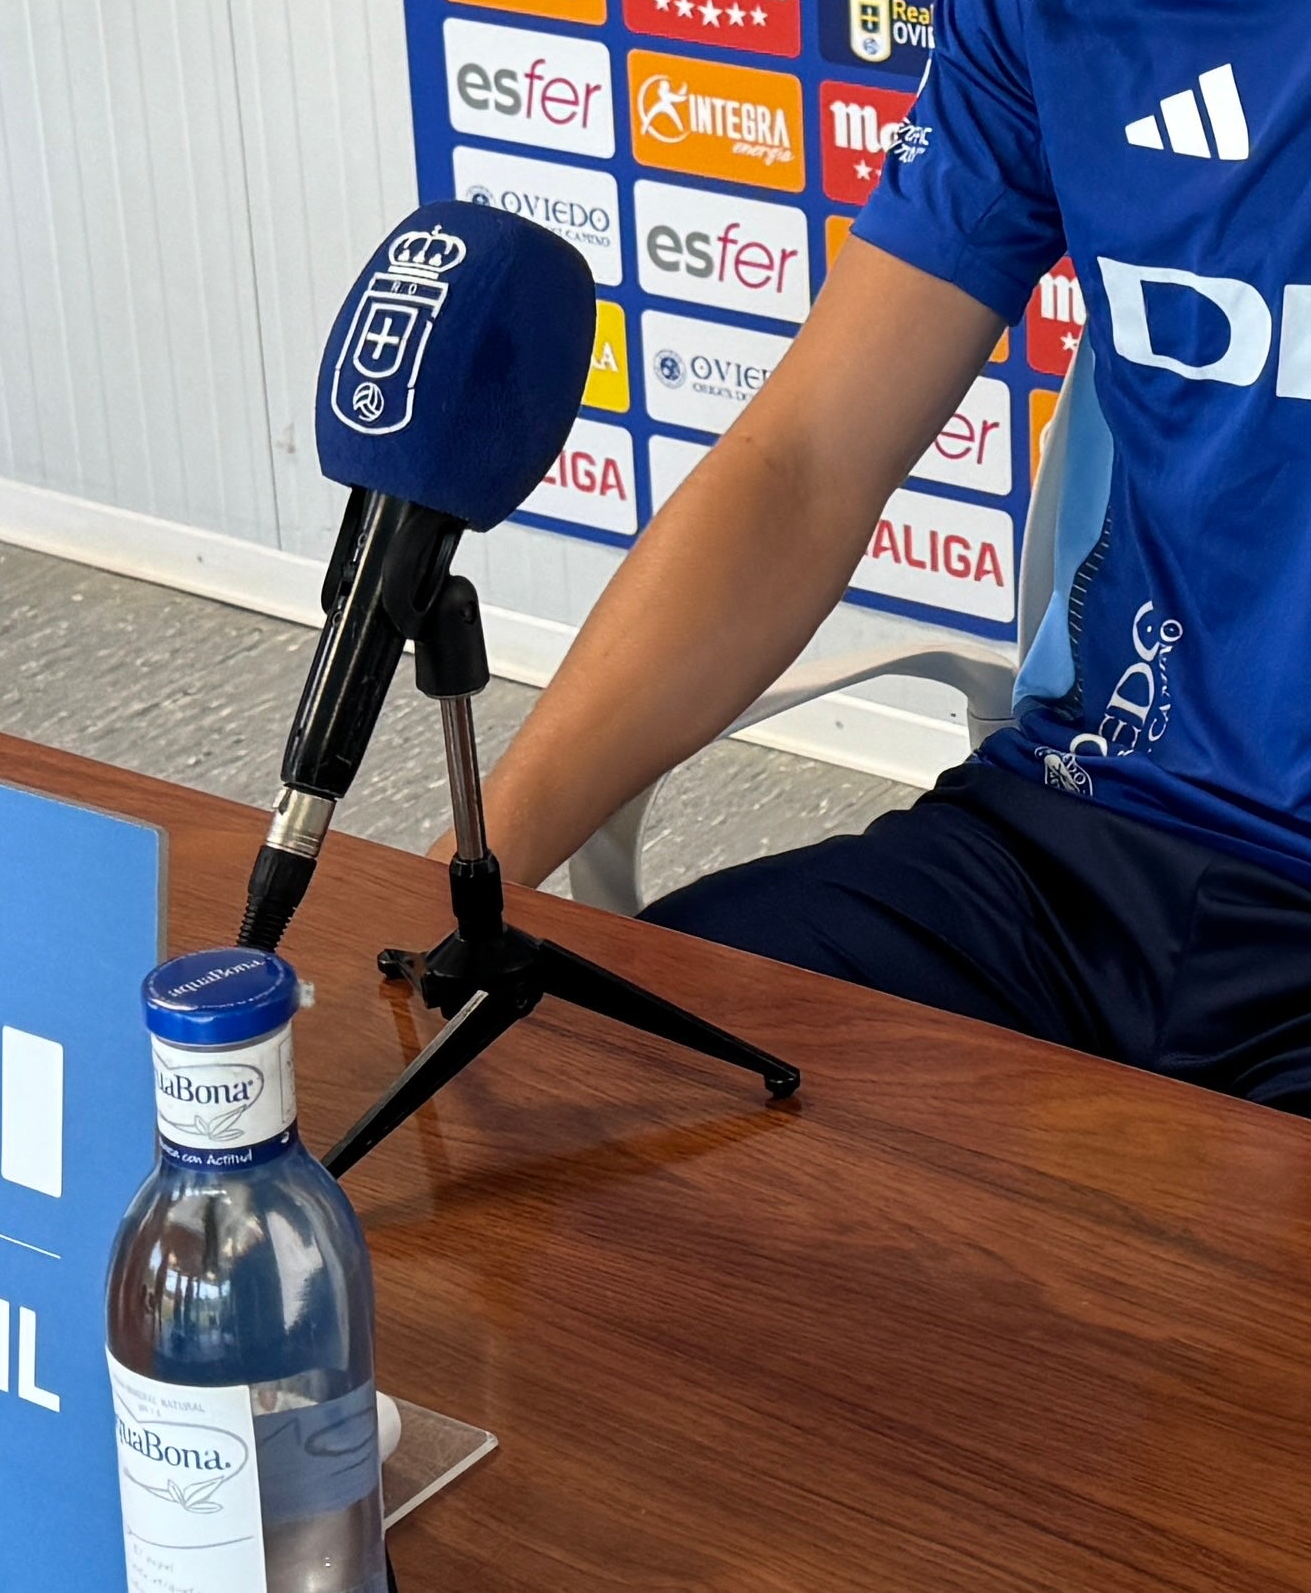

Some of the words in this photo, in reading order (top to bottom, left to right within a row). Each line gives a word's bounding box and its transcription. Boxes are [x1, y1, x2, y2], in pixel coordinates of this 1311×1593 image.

[457, 59, 601, 130] esfer
[690, 99, 789, 148] INTEGRA
[501, 191, 610, 231] OVIEDO
[647, 222, 798, 294] esfer
[863, 519, 1004, 587] ALIGA
